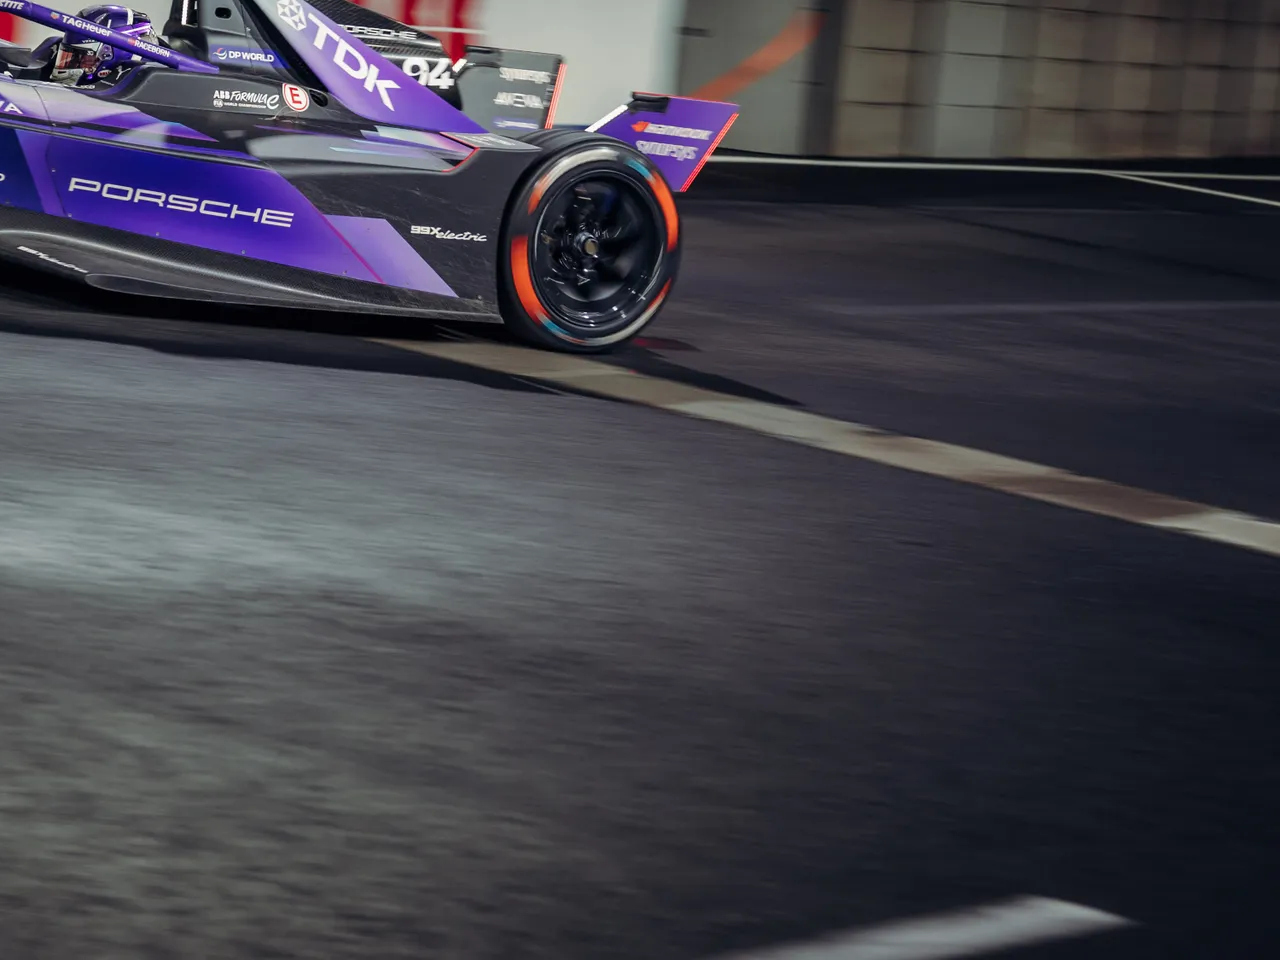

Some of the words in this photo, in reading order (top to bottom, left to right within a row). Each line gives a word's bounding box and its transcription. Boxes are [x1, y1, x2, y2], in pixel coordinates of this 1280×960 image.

[337, 24, 418, 40] ORSCHE
[134, 39, 171, 58] RACEBORN
[228, 50, 241, 60] DP
[241, 51, 275, 63] WORLD
[307, 12, 402, 112] TDK
[402, 56, 455, 90] 94
[289, 86, 303, 105] E
[69, 177, 295, 227] PORSCHE
